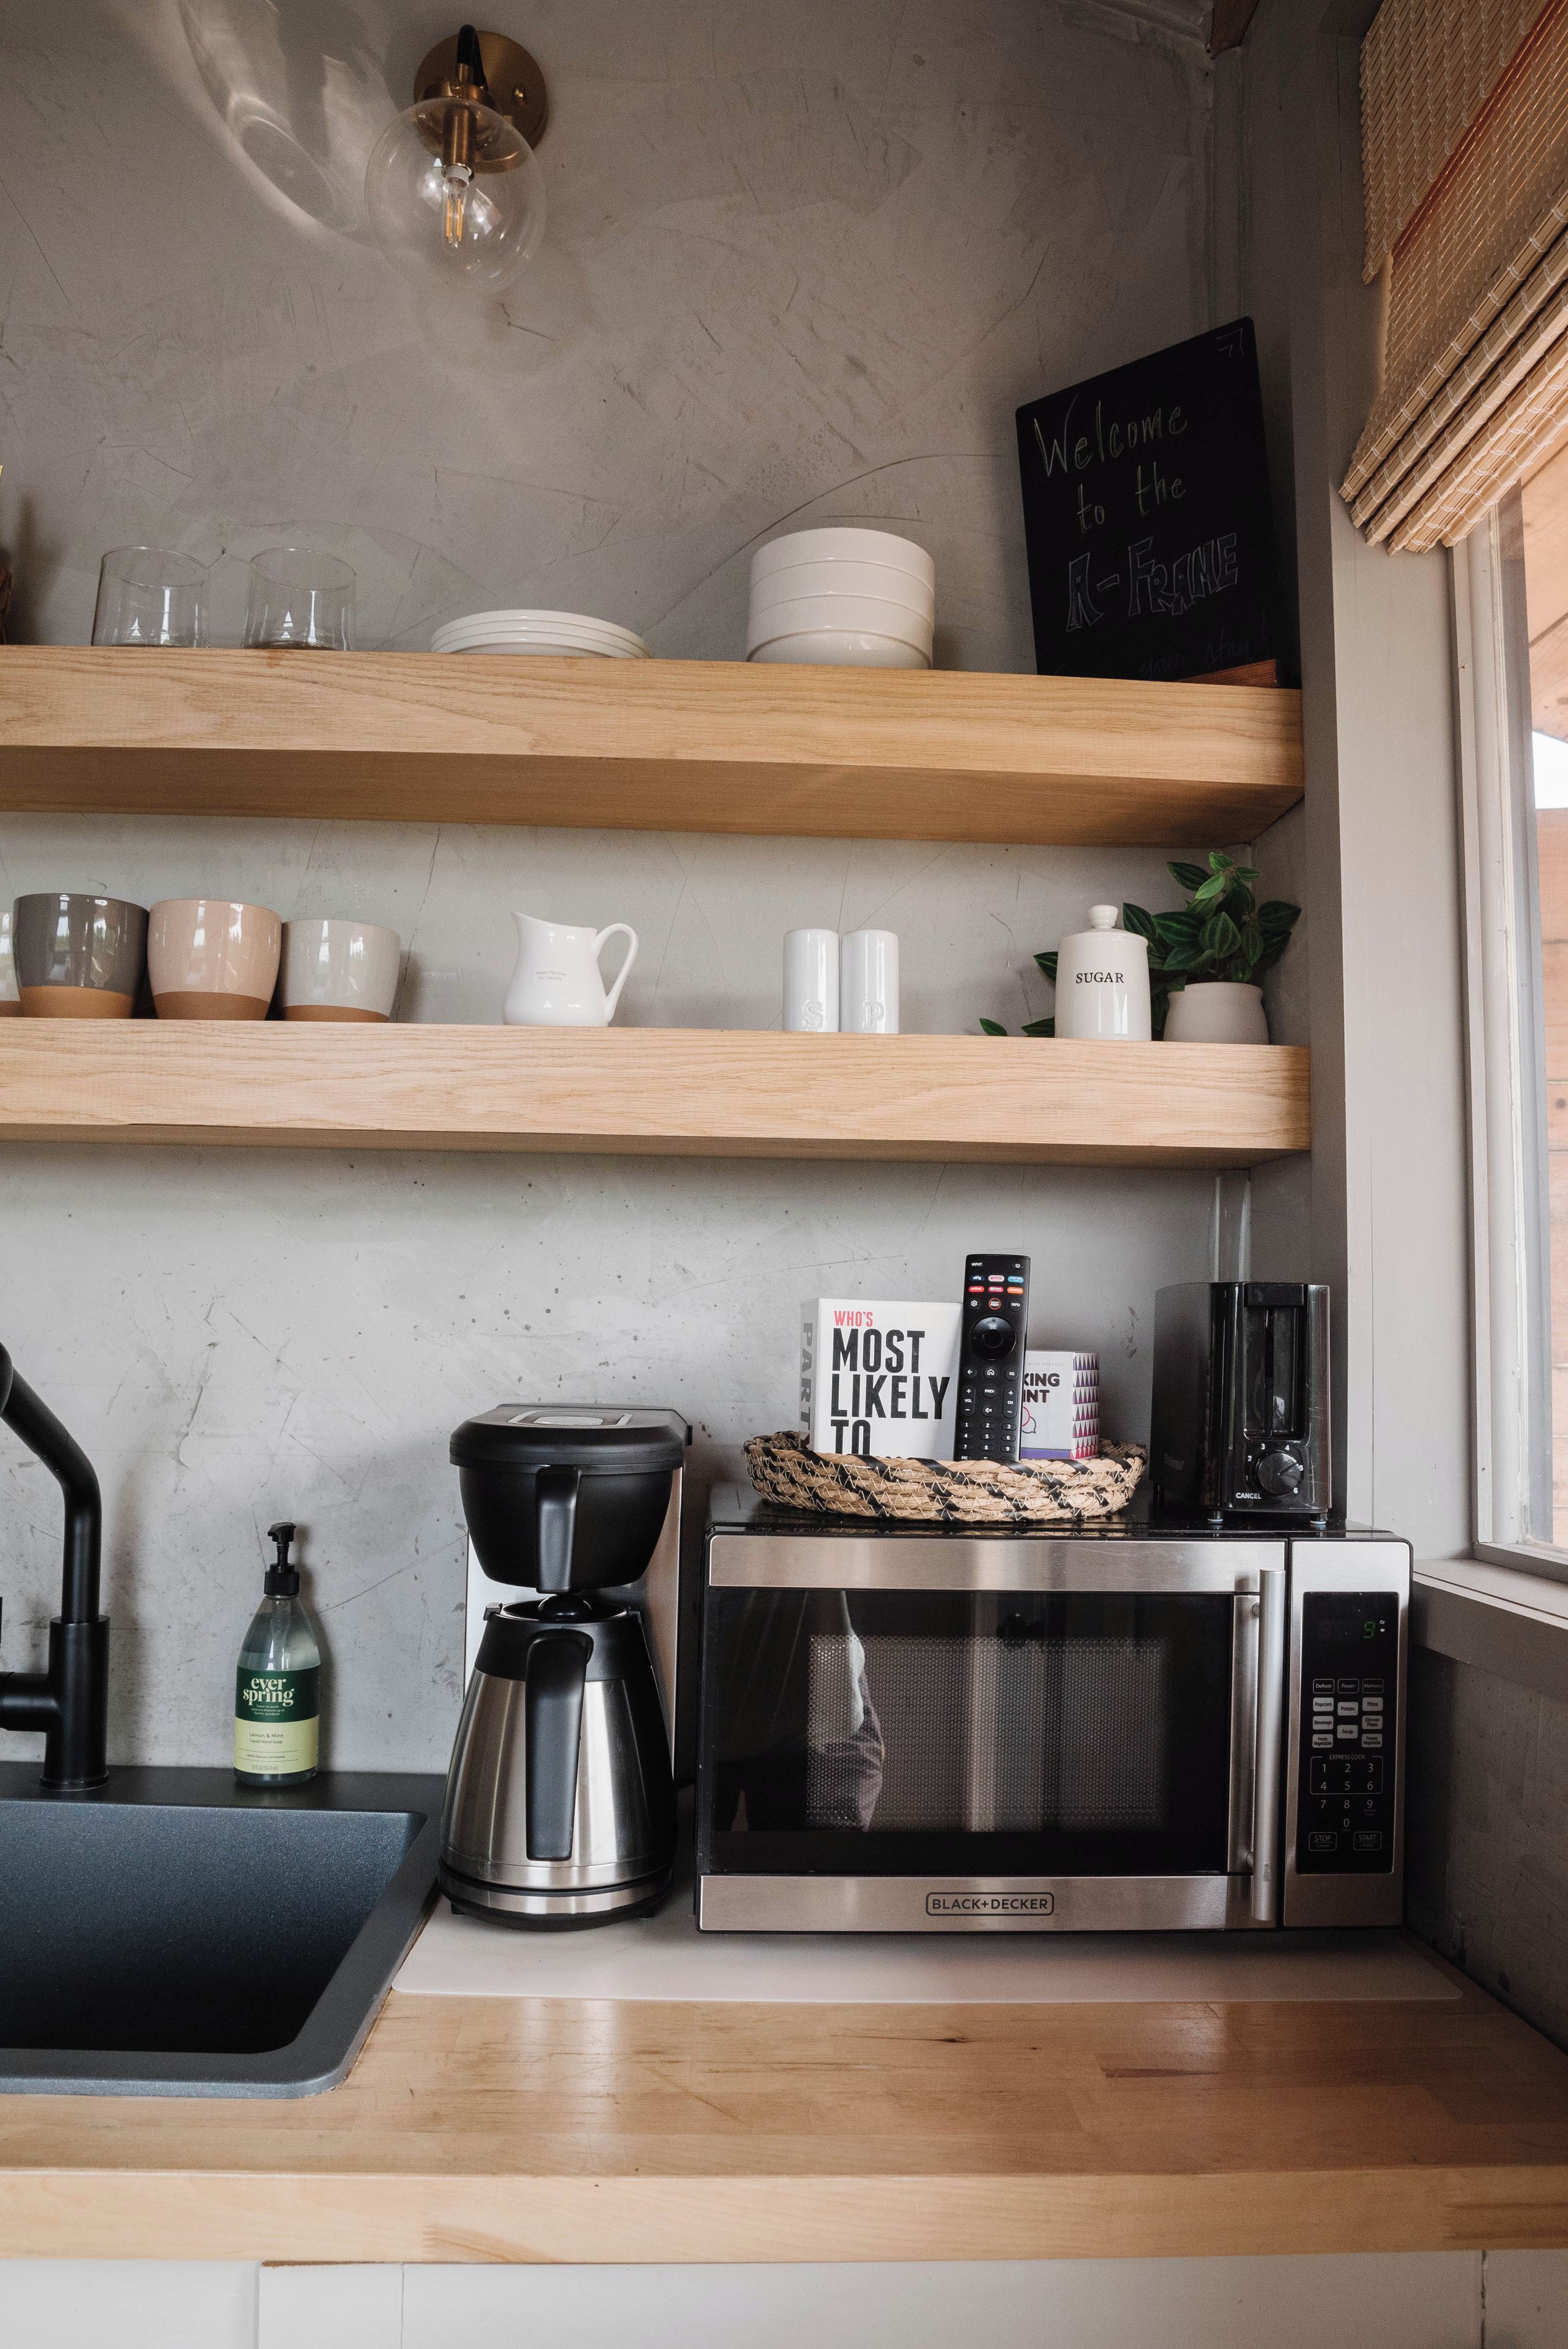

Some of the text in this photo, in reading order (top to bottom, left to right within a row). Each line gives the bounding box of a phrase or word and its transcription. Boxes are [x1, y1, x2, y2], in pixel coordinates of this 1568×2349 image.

[1034, 393, 1188, 477] Welcome
[1077, 462, 1186, 538] to the
[1076, 972, 1124, 984] SUGAR
[802, 999, 825, 1030] S
[861, 1000, 886, 1030] P
[834, 1310, 874, 1327] WHO'S
[832, 1327, 926, 1373] MOST
[830, 1373, 951, 1420] LIKELY
[830, 1419, 871, 1455] TO
[251, 1678, 287, 1690] ever
[243, 1688, 294, 1707] spring
[1322, 1764, 1326, 1773] 1
[1345, 1763, 1351, 1773] 2
[1368, 1763, 1373, 1772] 3
[1320, 1781, 1327, 1791] 4
[1344, 1781, 1350, 1791] 5
[1367, 1781, 1373, 1791] 6
[1320, 1800, 1326, 1809] 7
[1343, 1799, 1350, 1809] 8
[1367, 1799, 1373, 1808] 9
[1343, 1817, 1350, 1827] 0
[932, 1899, 1048, 1909] BLACK+DECKER
